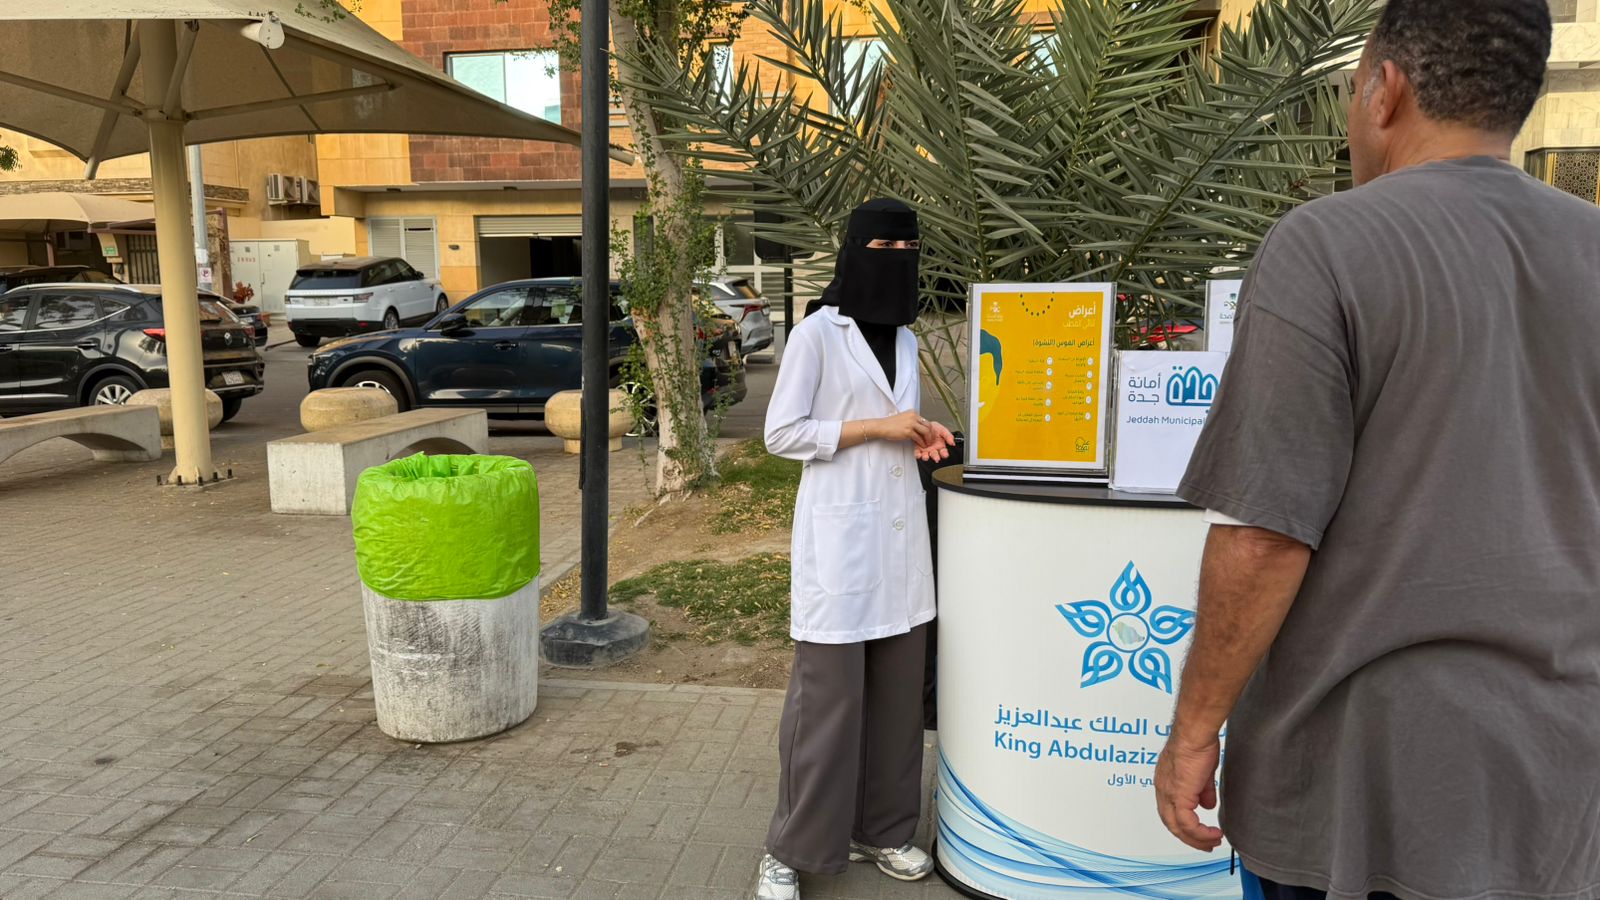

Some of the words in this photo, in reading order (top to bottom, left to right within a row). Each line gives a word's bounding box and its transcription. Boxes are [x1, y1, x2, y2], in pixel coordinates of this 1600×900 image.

[1068, 301, 1096, 318] أعراض
[1077, 337, 1095, 348] أعراض
[1128, 372, 1161, 389] أمانة
[1128, 390, 1160, 406] جدة
[1126, 415, 1160, 424] Jeddah
[994, 704, 1082, 732] عبدالعزيز
[1089, 716, 1148, 735] الملك
[994, 731, 1042, 758] King
[1047, 740, 1159, 765] Abdulaziz
[1107, 774, 1136, 786] الأول
